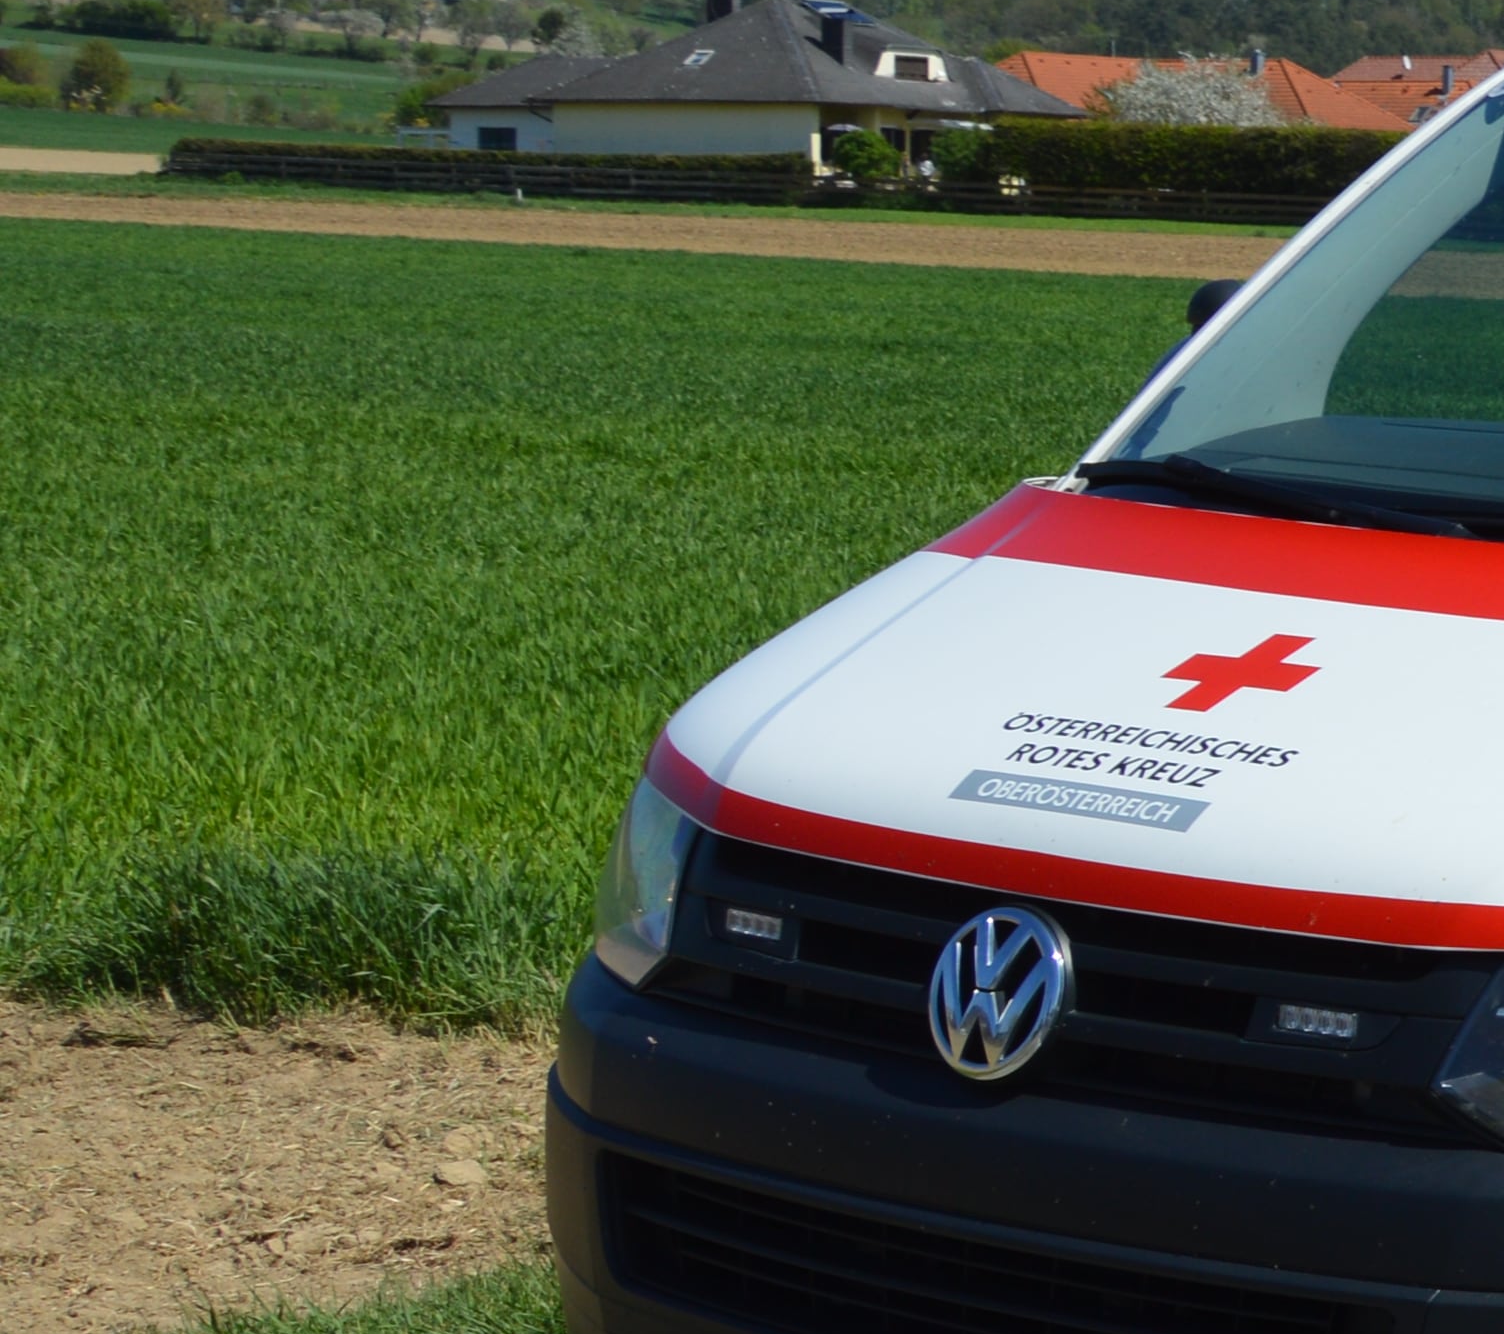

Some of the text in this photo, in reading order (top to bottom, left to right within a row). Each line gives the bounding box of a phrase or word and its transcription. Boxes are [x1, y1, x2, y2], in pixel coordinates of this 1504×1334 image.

[1002, 711, 1300, 769] ÖSTERREICHISCHES
[1005, 743, 1223, 788] ROTES KREUZ
[976, 778, 1181, 824] OBERÖSTERREICH
